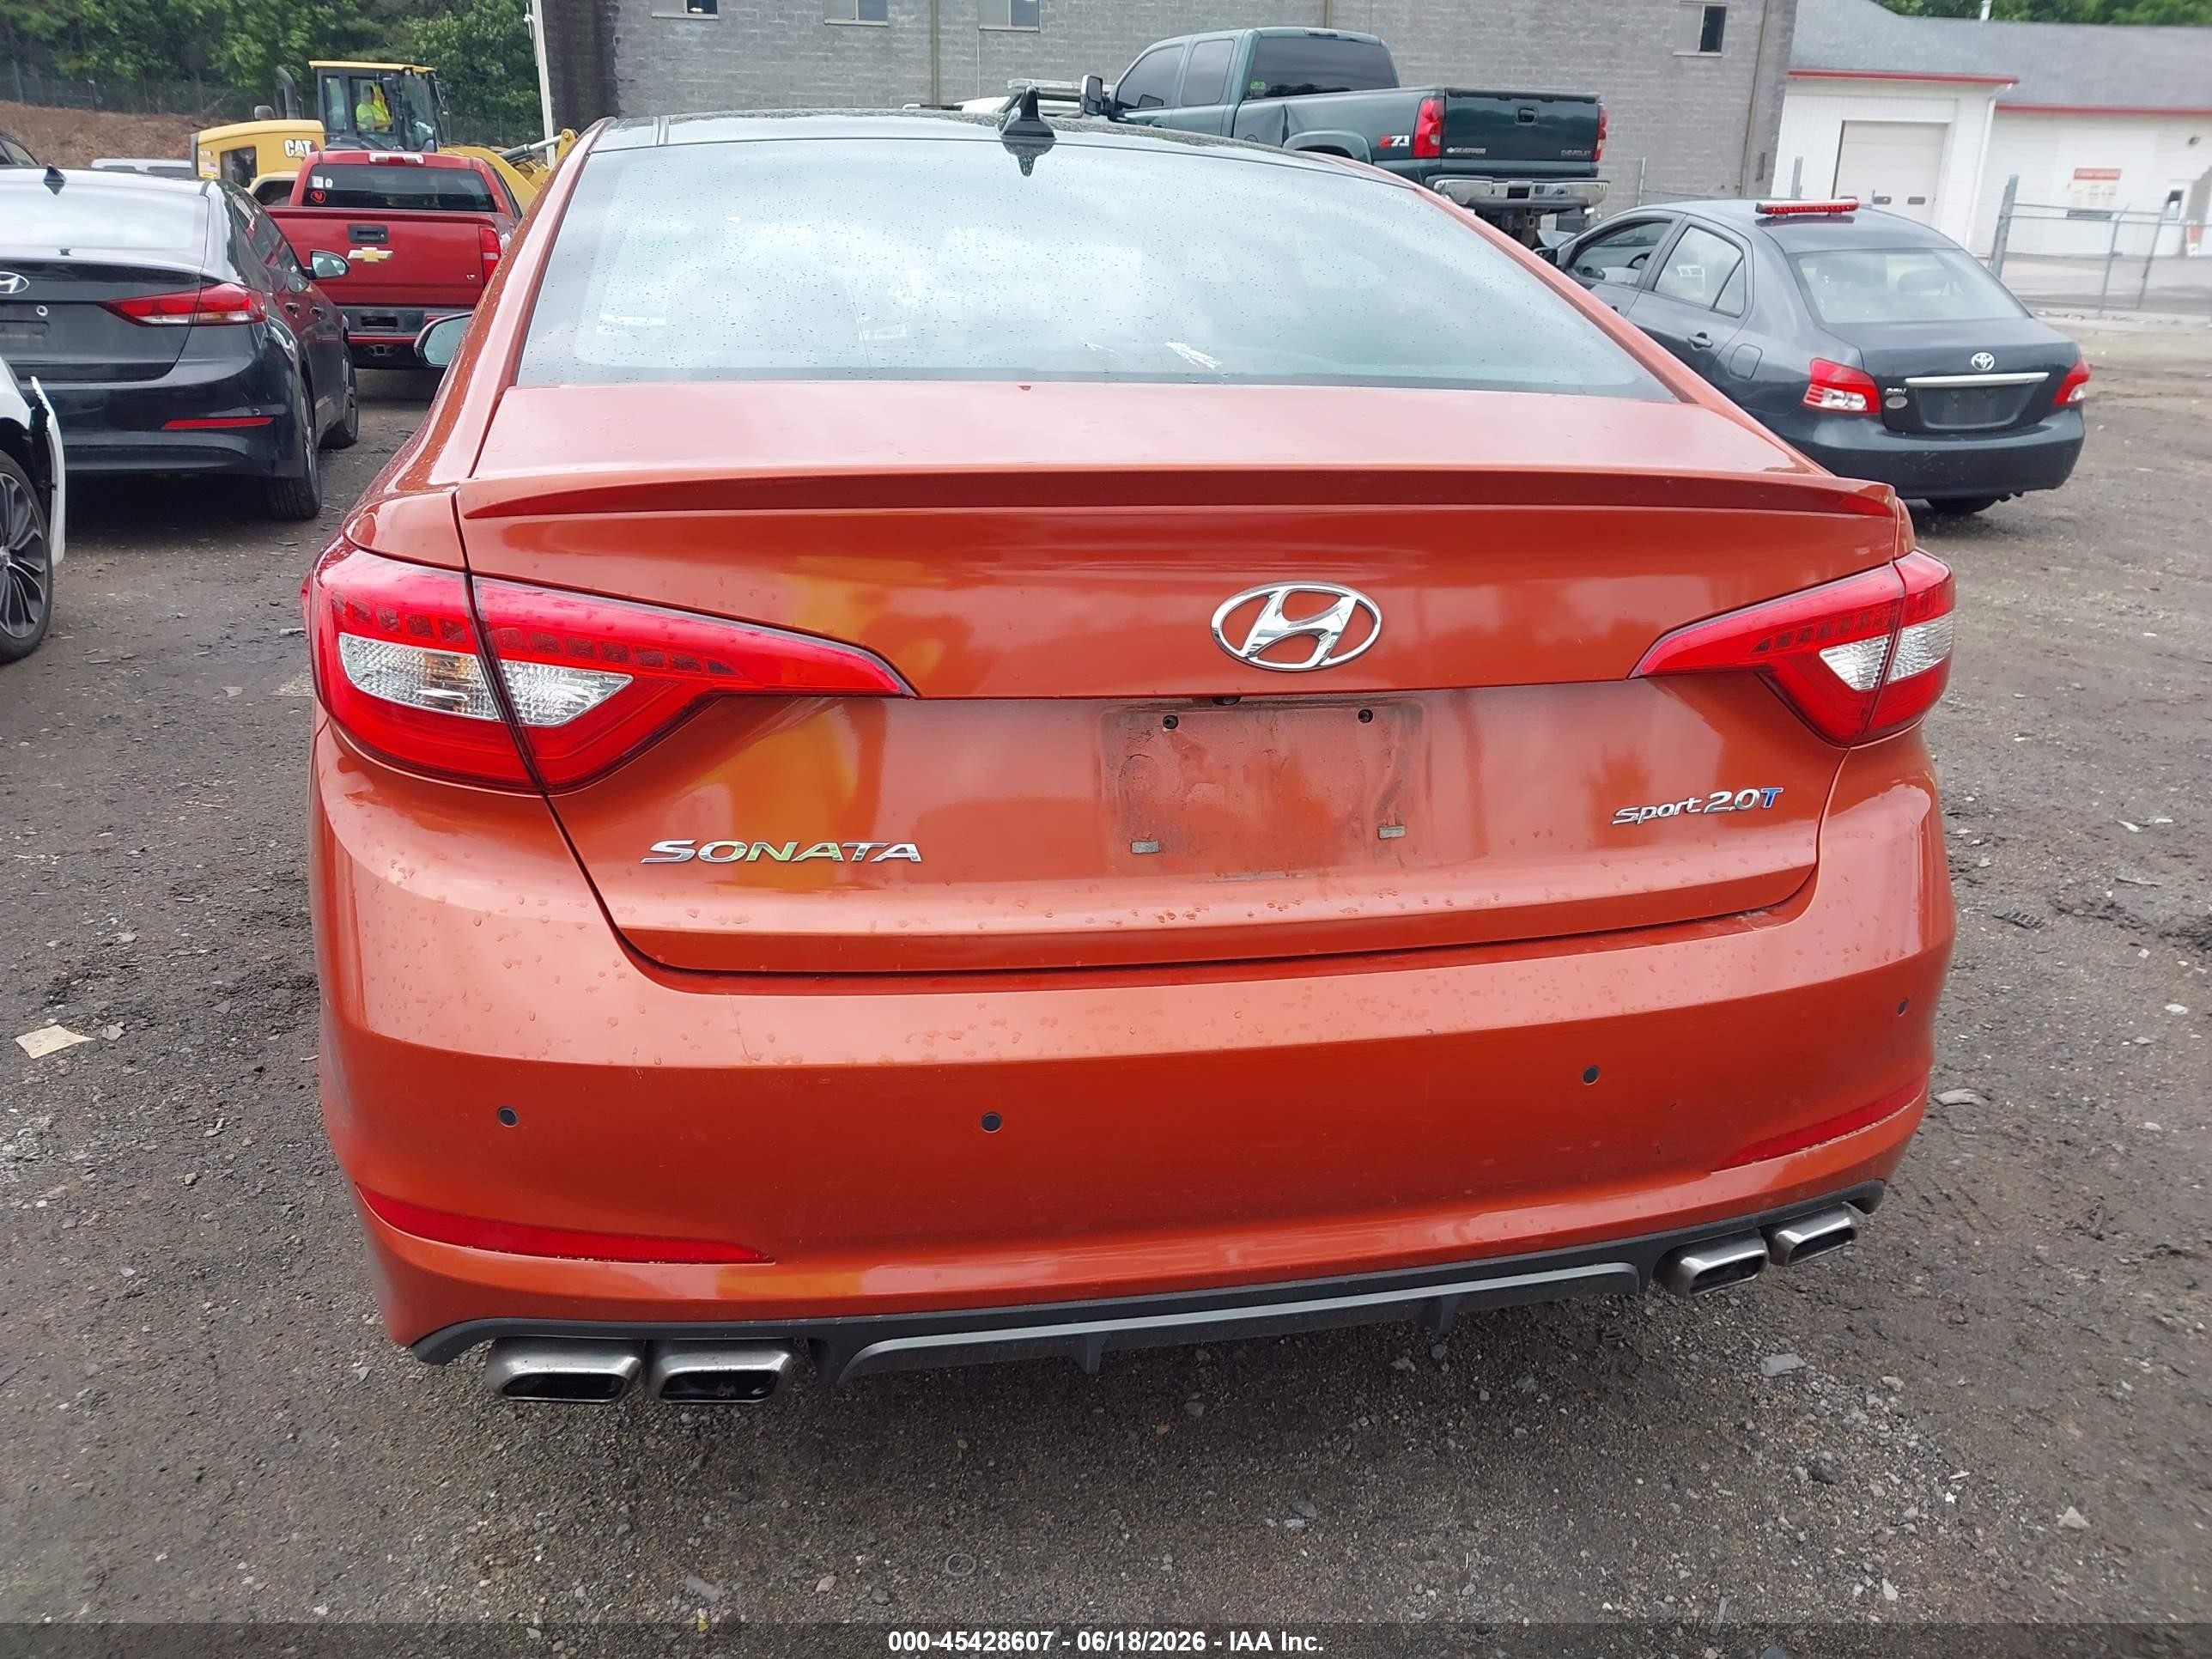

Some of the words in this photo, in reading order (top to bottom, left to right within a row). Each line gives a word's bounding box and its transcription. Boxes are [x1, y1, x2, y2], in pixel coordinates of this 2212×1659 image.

[284, 138, 313, 158] CAT
[1379, 135, 1410, 149] Z71
[640, 839, 923, 864] SONATA
